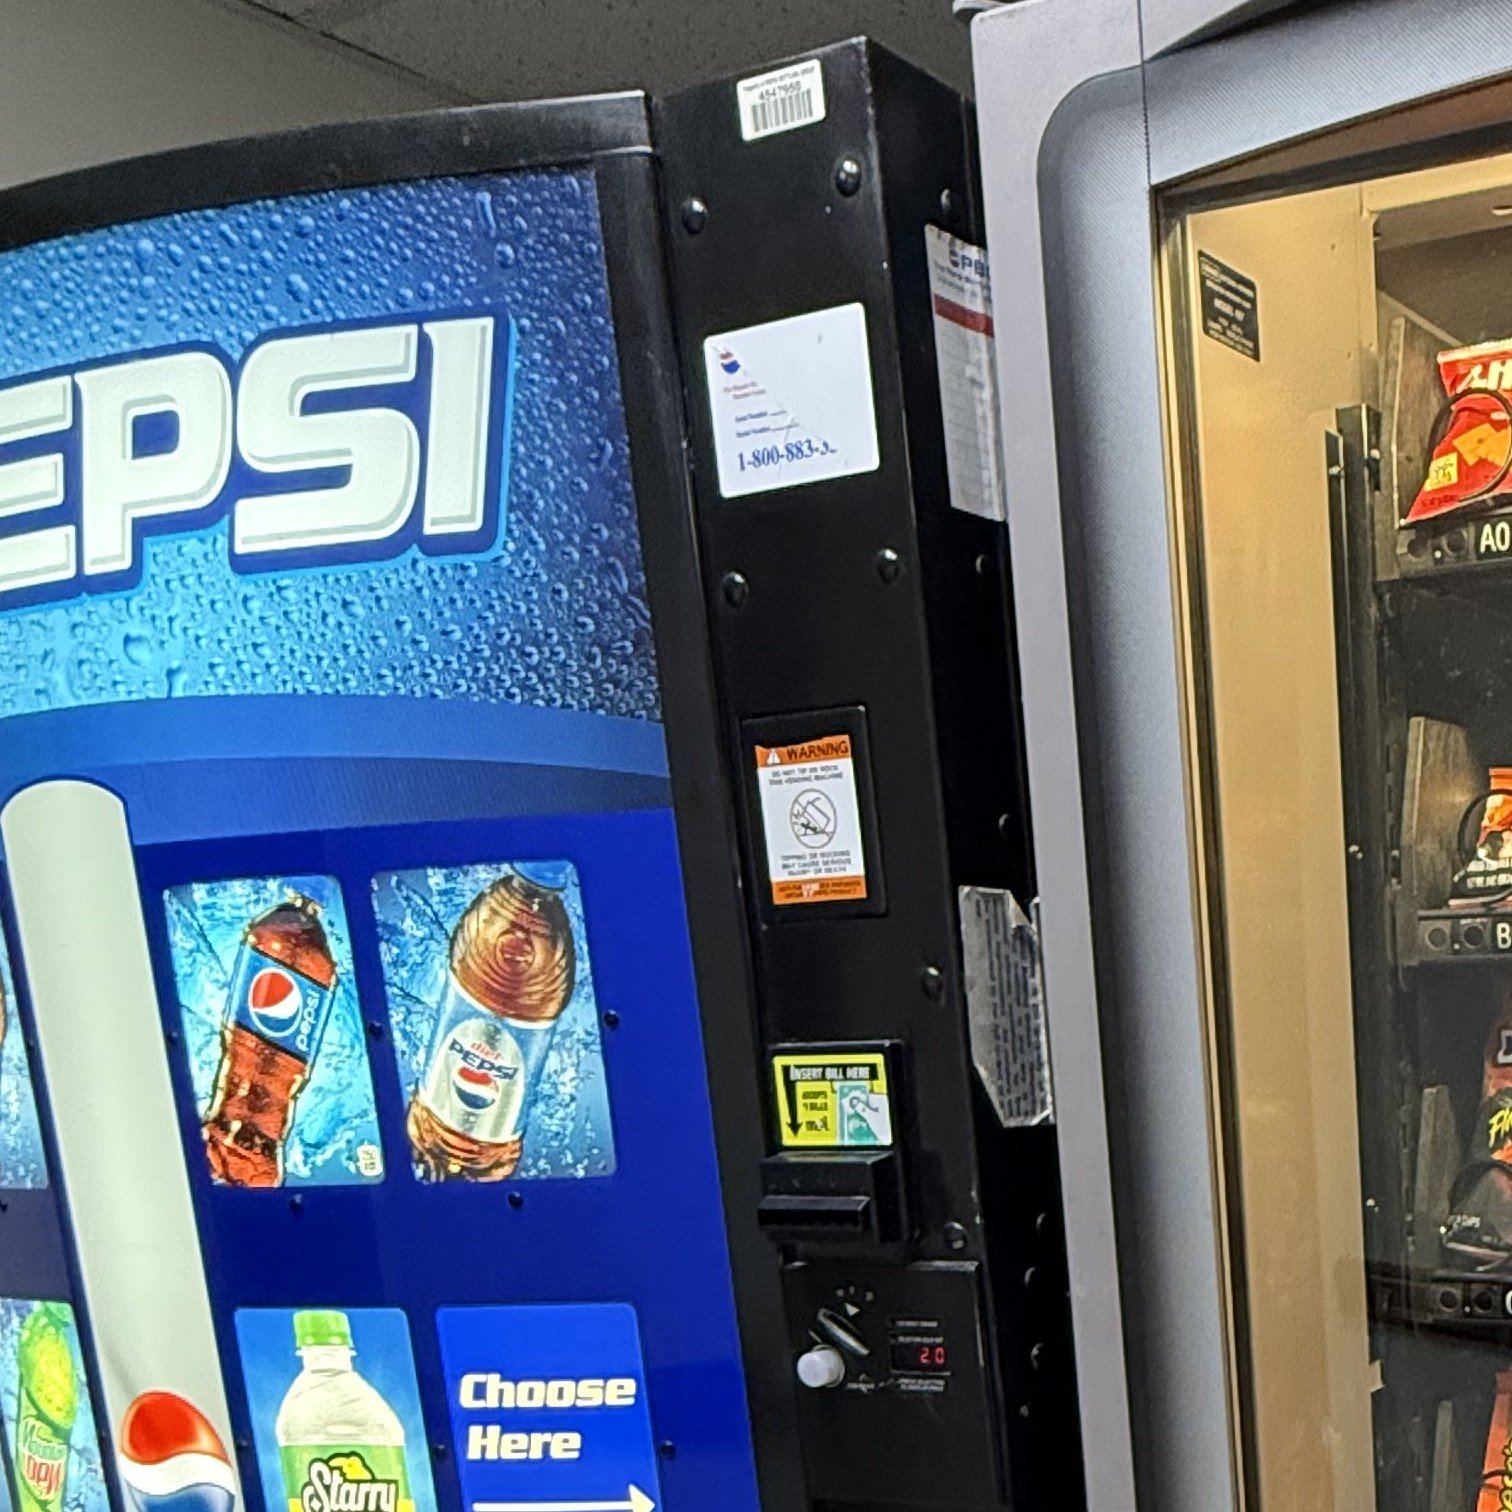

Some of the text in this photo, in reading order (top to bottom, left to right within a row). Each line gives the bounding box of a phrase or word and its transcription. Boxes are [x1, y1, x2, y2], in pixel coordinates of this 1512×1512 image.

[1480, 523, 1511, 553] A0
[786, 740, 849, 761] WARNING
[295, 989, 320, 1051] pepsi
[449, 1038, 519, 1080] PEPSI
[471, 1042, 503, 1061] diet
[460, 1373, 636, 1408] Choose
[467, 1424, 581, 1460] Here
